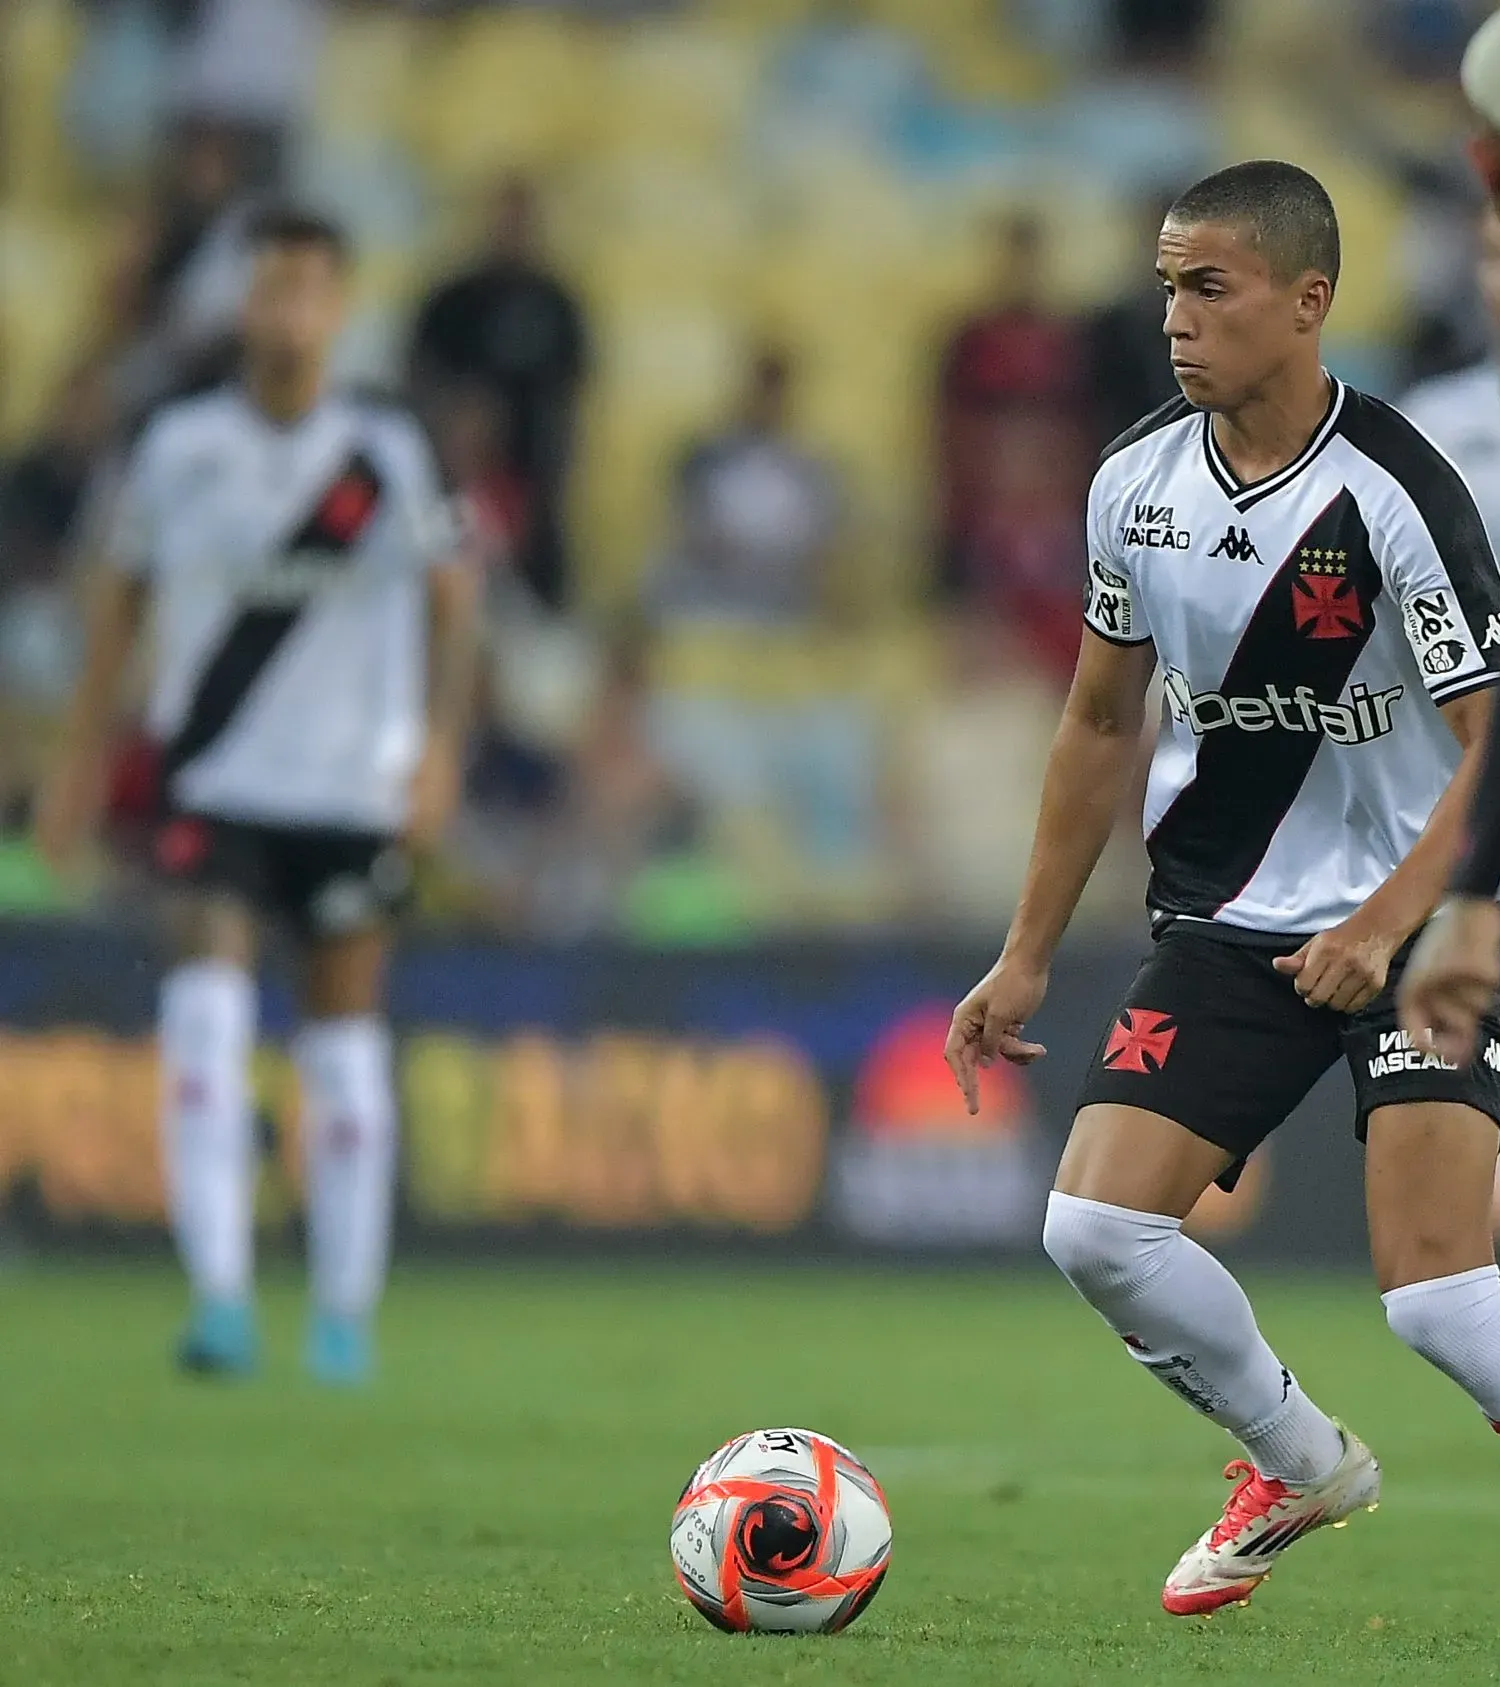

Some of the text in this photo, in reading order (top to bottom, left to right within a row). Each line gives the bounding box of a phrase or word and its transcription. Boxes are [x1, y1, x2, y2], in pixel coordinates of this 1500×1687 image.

[1133, 503, 1175, 525] VVA
[1121, 597, 1132, 635] DELIVERY
[1403, 602, 1423, 647] DELIVERY
[1186, 680, 1405, 746] betfair
